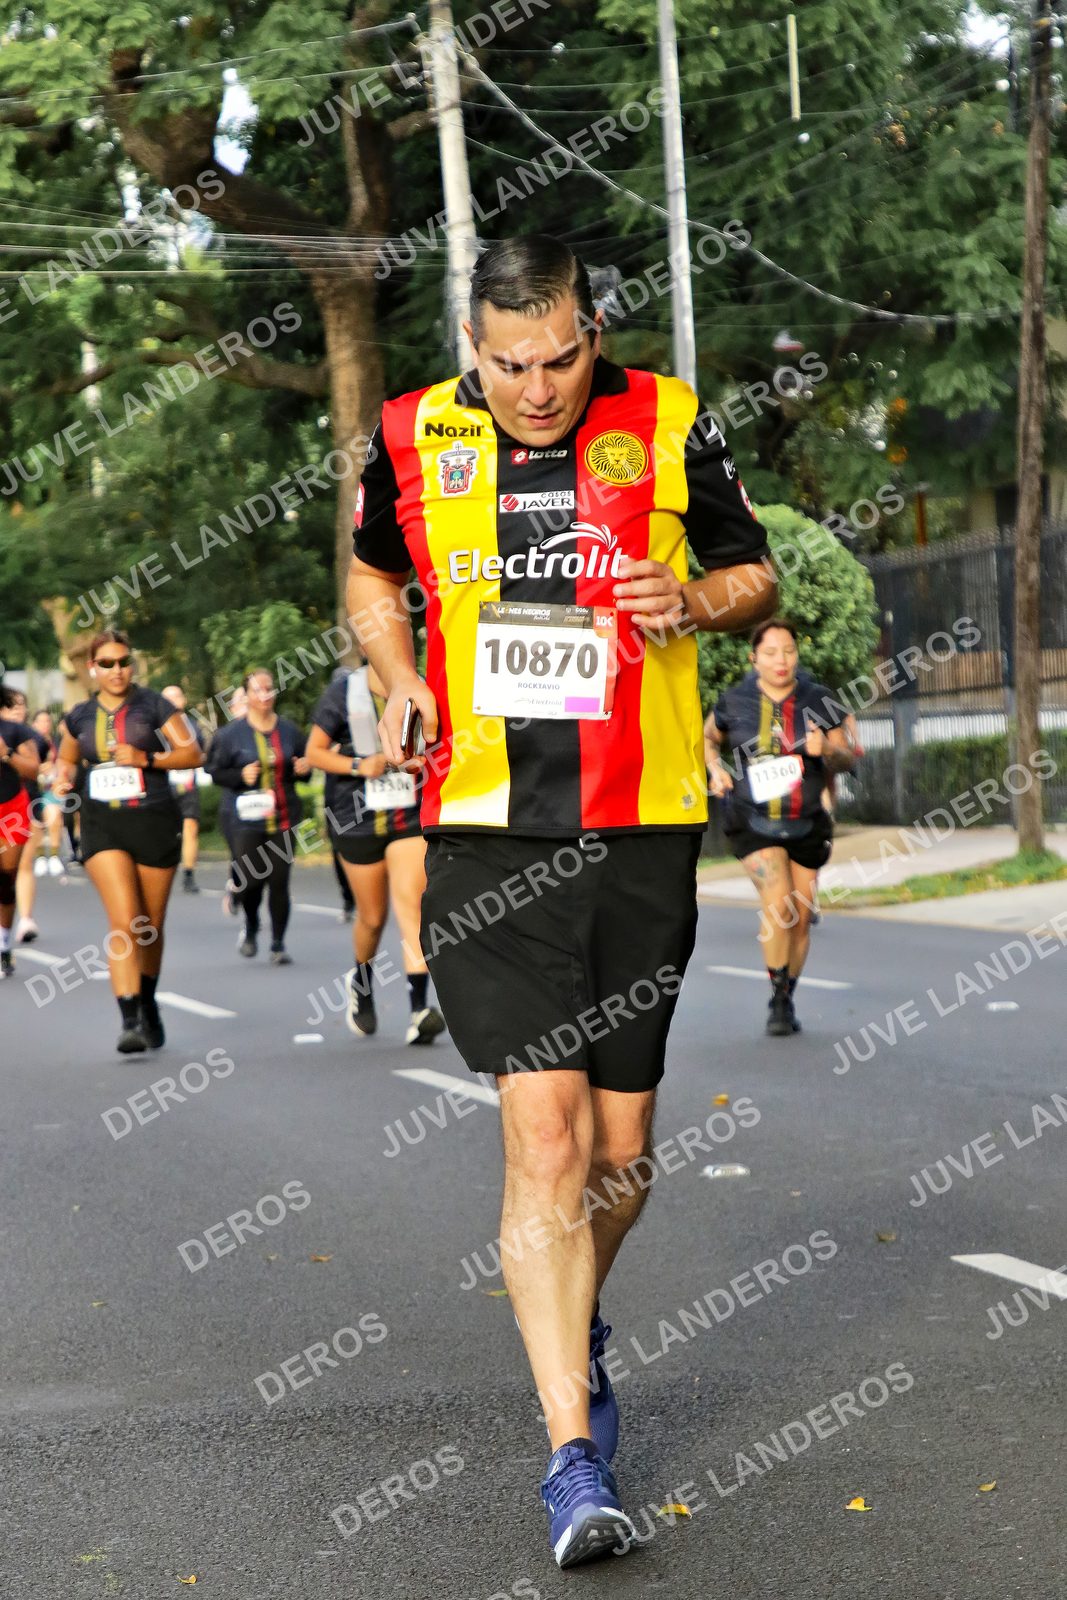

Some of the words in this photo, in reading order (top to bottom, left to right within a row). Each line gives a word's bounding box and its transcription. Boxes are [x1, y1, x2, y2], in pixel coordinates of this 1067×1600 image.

[425, 423, 482, 438] Nazil
[522, 498, 573, 511] JAVER
[448, 545, 629, 584] Electrolit
[484, 638, 599, 679] 10870
